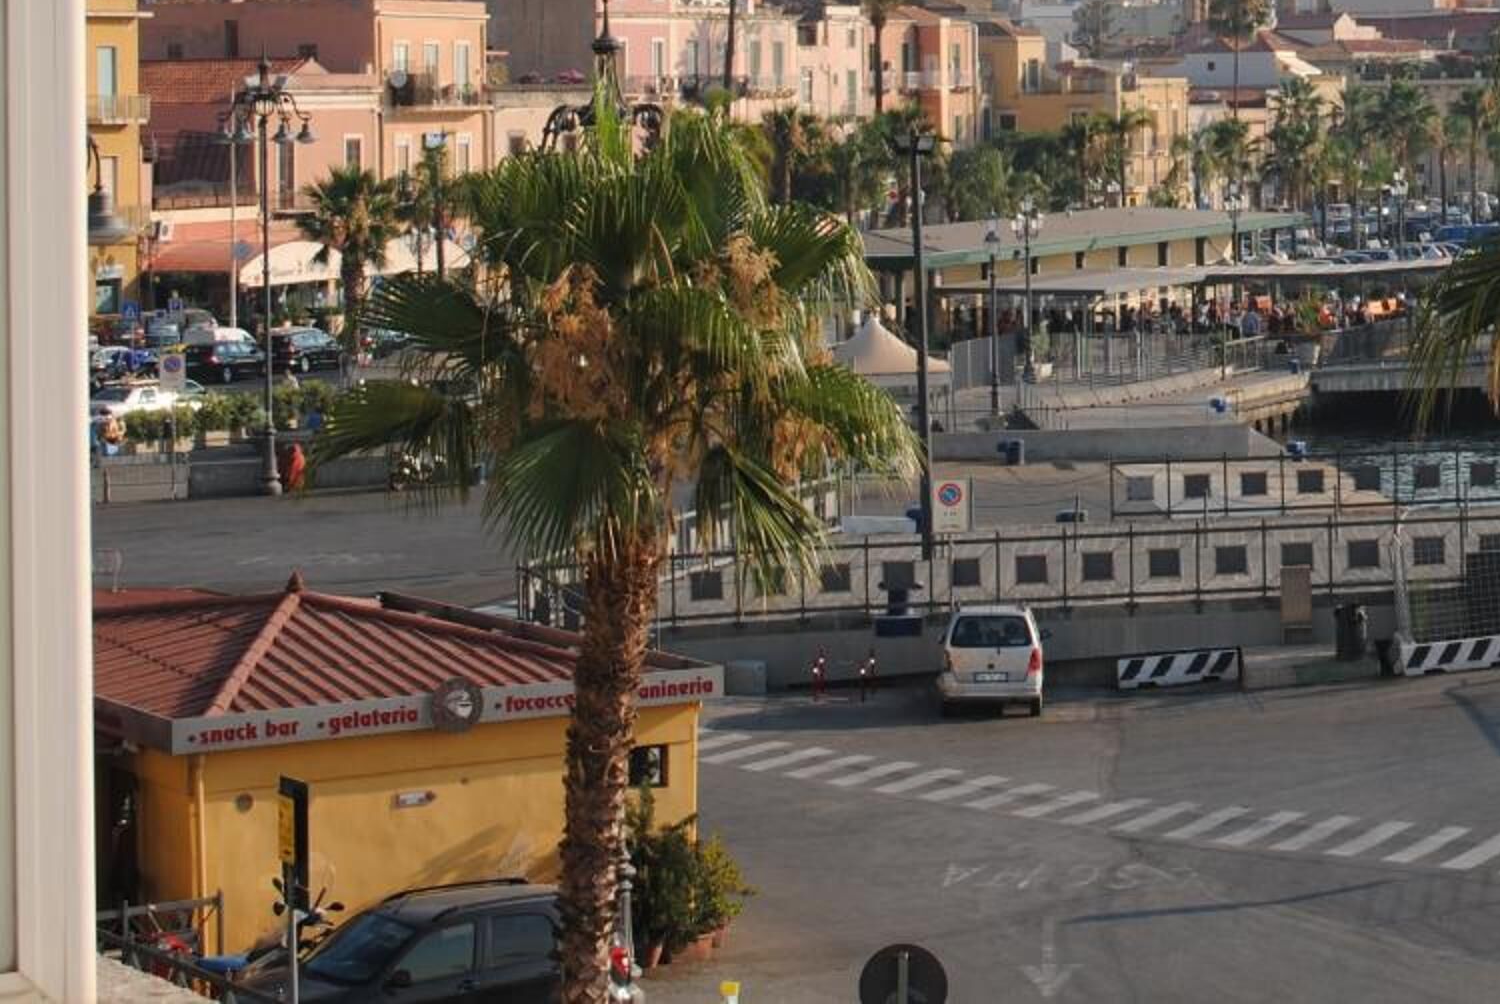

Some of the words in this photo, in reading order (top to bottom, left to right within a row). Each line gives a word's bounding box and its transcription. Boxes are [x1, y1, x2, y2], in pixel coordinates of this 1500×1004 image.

[200, 722, 258, 744] snack
[265, 718, 299, 737] bar
[328, 705, 418, 735] gelateria
[506, 693, 576, 713] focacce
[639, 676, 714, 700] anineria
